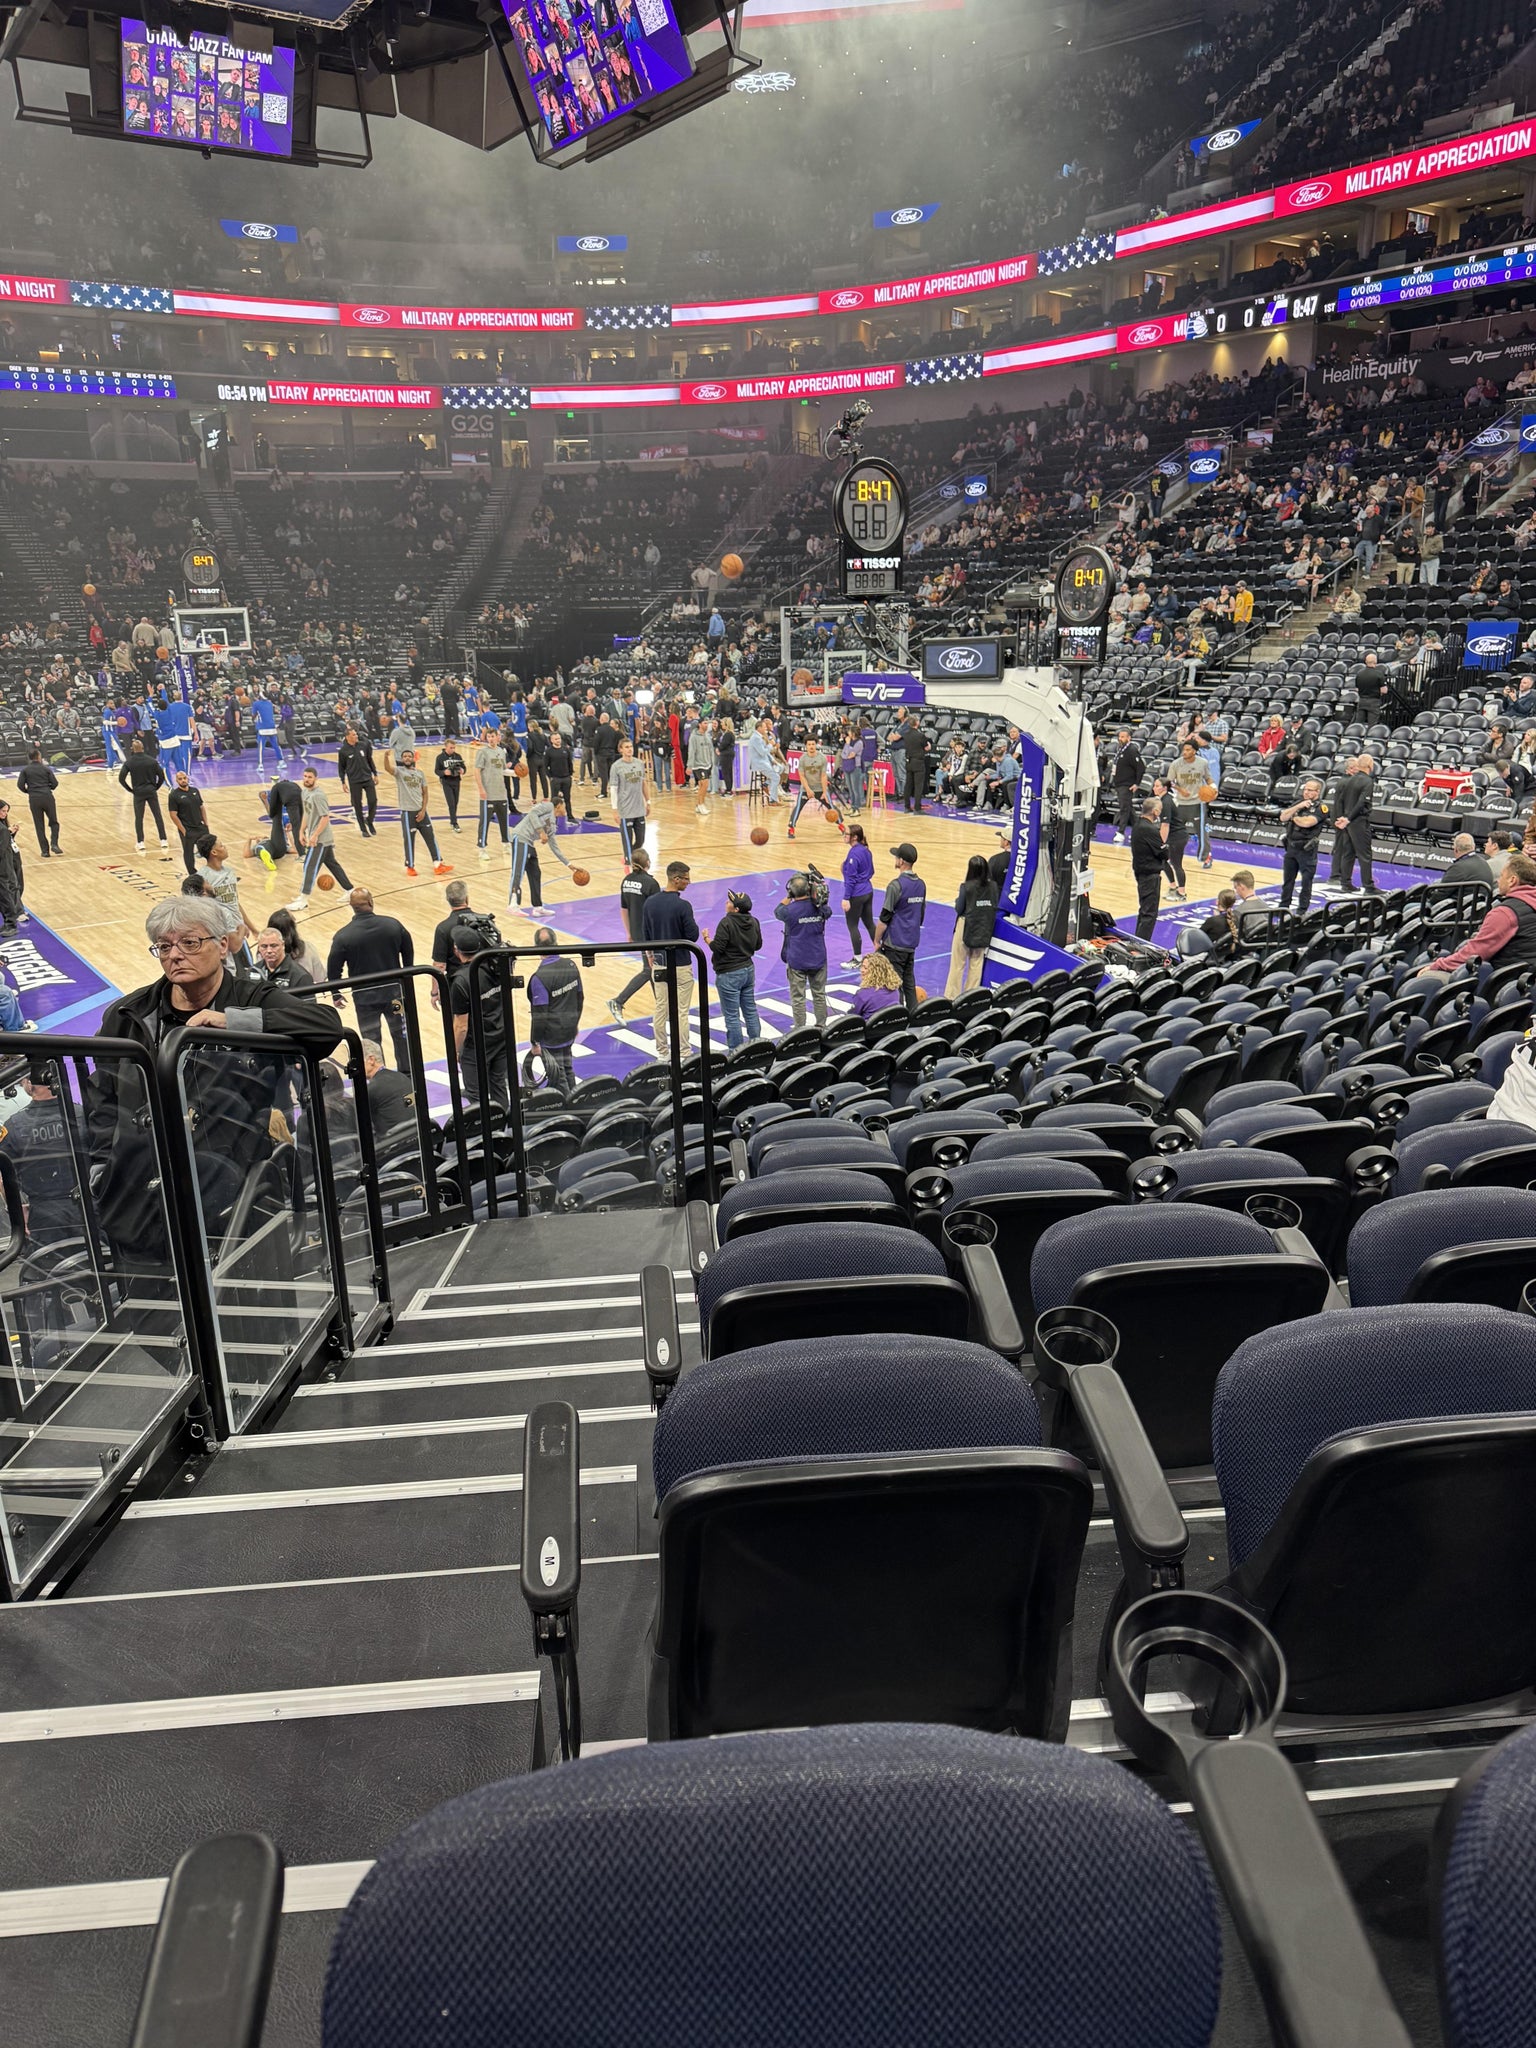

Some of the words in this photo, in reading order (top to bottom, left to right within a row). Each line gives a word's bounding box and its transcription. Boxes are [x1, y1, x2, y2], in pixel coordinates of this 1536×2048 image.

[190, 36, 219, 56] JAZZ
[222, 41, 244, 60] FAN
[247, 50, 273, 66] CAM
[1346, 157, 1413, 194] MILITARY
[1416, 127, 1532, 177] APPRECIATION
[1505, 257, 1513, 267] 0
[1527, 253, 1534, 263] 0
[1504, 270, 1512, 280] 0
[1525, 266, 1532, 276] 0
[15, 280, 56, 299] NIGHT
[834, 291, 861, 308] Ford
[874, 282, 921, 303] MILITARY
[924, 270, 996, 293] APPRECIATION
[998, 259, 1028, 281] NIGHT
[1293, 295, 1319, 319] 8:47
[1324, 302, 1336, 314] 1ST
[356, 307, 385, 324] Ford
[402, 310, 453, 326] MILITARY
[458, 312, 538, 327] APPRECIATION
[541, 312, 575, 327] NIGHT
[1216, 314, 1226, 333] 0
[1243, 308, 1254, 328] 0
[1131, 325, 1160, 343] Ford
[1504, 343, 1536, 355] AMERIC
[1322, 358, 1419, 385] HealthEquity
[218, 384, 248, 401] 06:54
[250, 386, 267, 402] PM
[269, 384, 309, 401] LITARY
[313, 387, 394, 404] APPRECIATION
[397, 390, 431, 404] NIGHT
[695, 385, 724, 400] Ford
[737, 380, 785, 397] MILITARY
[787, 374, 862, 393] APPRECIATION
[864, 369, 895, 388] NIGHT
[451, 414, 494, 432] G2G
[857, 480, 892, 501] 8:47
[193, 555, 214, 567] 8:47
[861, 557, 901, 570] TISSOT
[1075, 568, 1103, 588] 8:47
[197, 587, 220, 595] TISSOT
[1069, 626, 1102, 636] TISSOT
[1019, 773, 1033, 825] FIRST
[1007, 827, 1030, 905] AMERICA
[32, 1123, 65, 1143] POLIC
[544, 1556, 555, 1566] M
